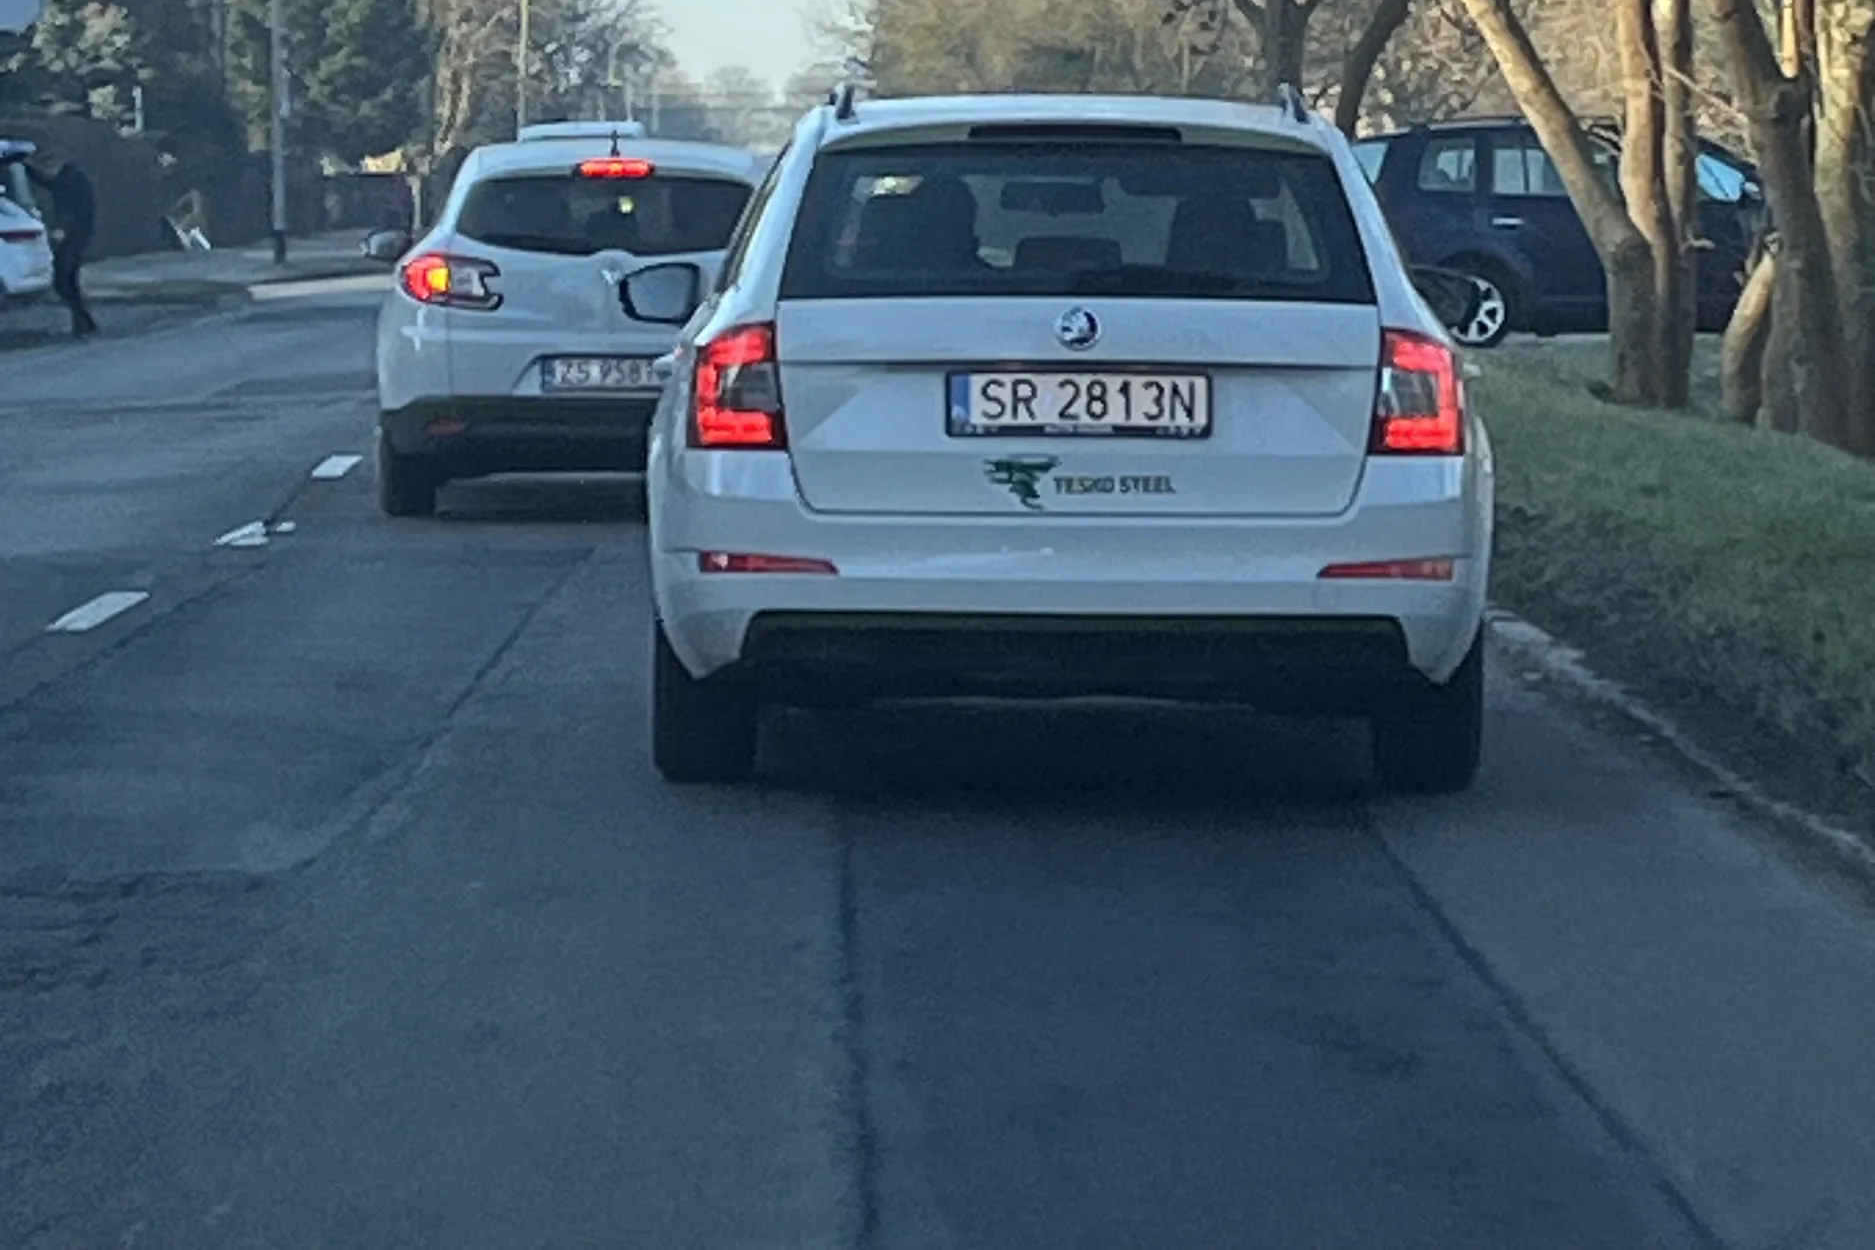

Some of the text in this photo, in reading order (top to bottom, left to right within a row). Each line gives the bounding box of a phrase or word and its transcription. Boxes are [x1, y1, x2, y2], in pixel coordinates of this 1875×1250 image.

[981, 379, 1196, 422] SR 2813N
[1053, 475, 1176, 494] TESKO STEEL
